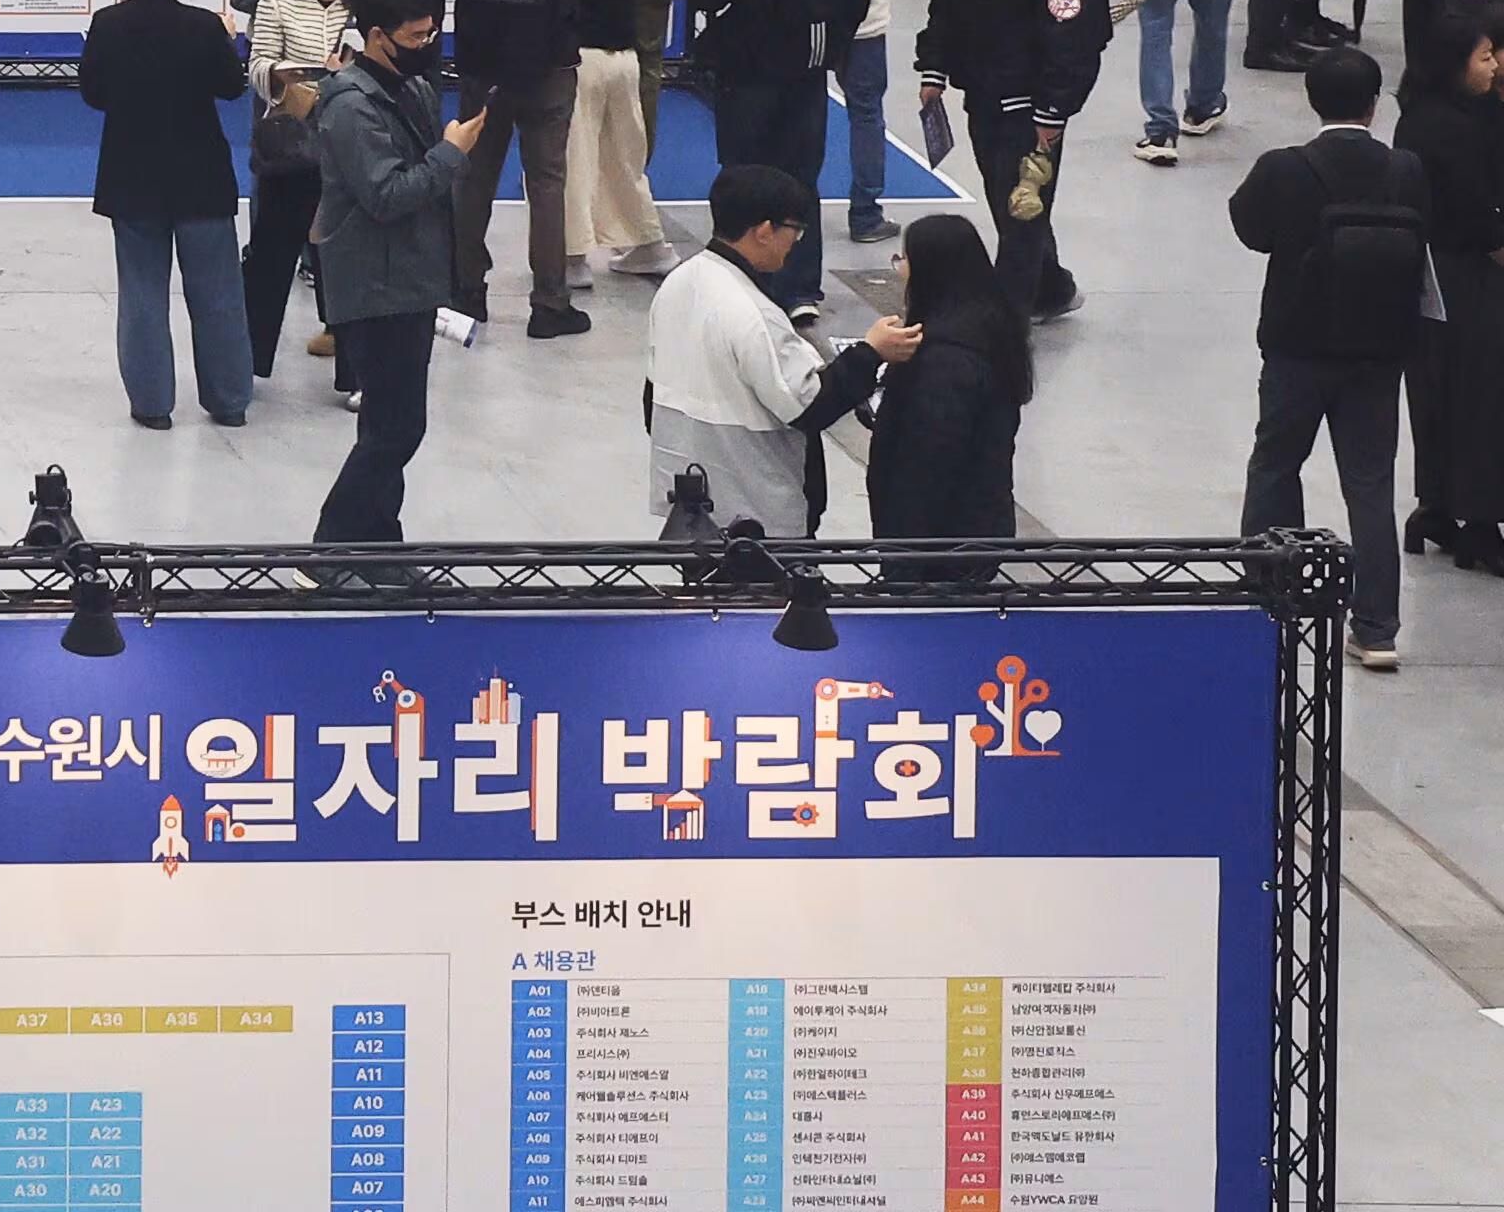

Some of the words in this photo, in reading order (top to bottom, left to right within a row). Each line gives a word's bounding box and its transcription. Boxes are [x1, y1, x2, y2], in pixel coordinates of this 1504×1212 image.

[186, 706, 560, 844] 일자리
[601, 703, 977, 842] 박람회
[510, 899, 567, 930] 부스
[574, 899, 629, 929] 배치
[637, 899, 692, 929] 안내
[511, 952, 528, 972] A
[533, 948, 597, 974] 채용관
[528, 985, 551, 997] A01
[240, 1011, 273, 1025] A34
[354, 1011, 384, 1025] A13
[527, 1006, 552, 1017] A02
[16, 1013, 48, 1027] A37
[527, 1027, 551, 1038] A03
[354, 1038, 385, 1054] A12
[526, 1048, 551, 1059] A04
[356, 1066, 382, 1082] A11
[961, 1089, 986, 1100] A39
[13, 1098, 49, 1113] A33
[90, 1096, 122, 1112] A23
[353, 1095, 383, 1110] A10
[527, 1112, 550, 1123] A07
[961, 1110, 986, 1121] A40
[15, 1127, 48, 1141] A32
[89, 1126, 122, 1141] A22
[351, 1124, 385, 1138] A09
[963, 1131, 985, 1141] A41
[15, 1155, 45, 1169] A31
[91, 1153, 120, 1169] A21
[351, 1152, 385, 1167] A08
[961, 1152, 985, 1163] A42
[527, 1175, 549, 1186] A10
[961, 1173, 985, 1184] A43
[14, 1183, 47, 1197] A30
[89, 1183, 122, 1197] A20
[351, 1180, 384, 1195] A07
[528, 1196, 548, 1207] A11
